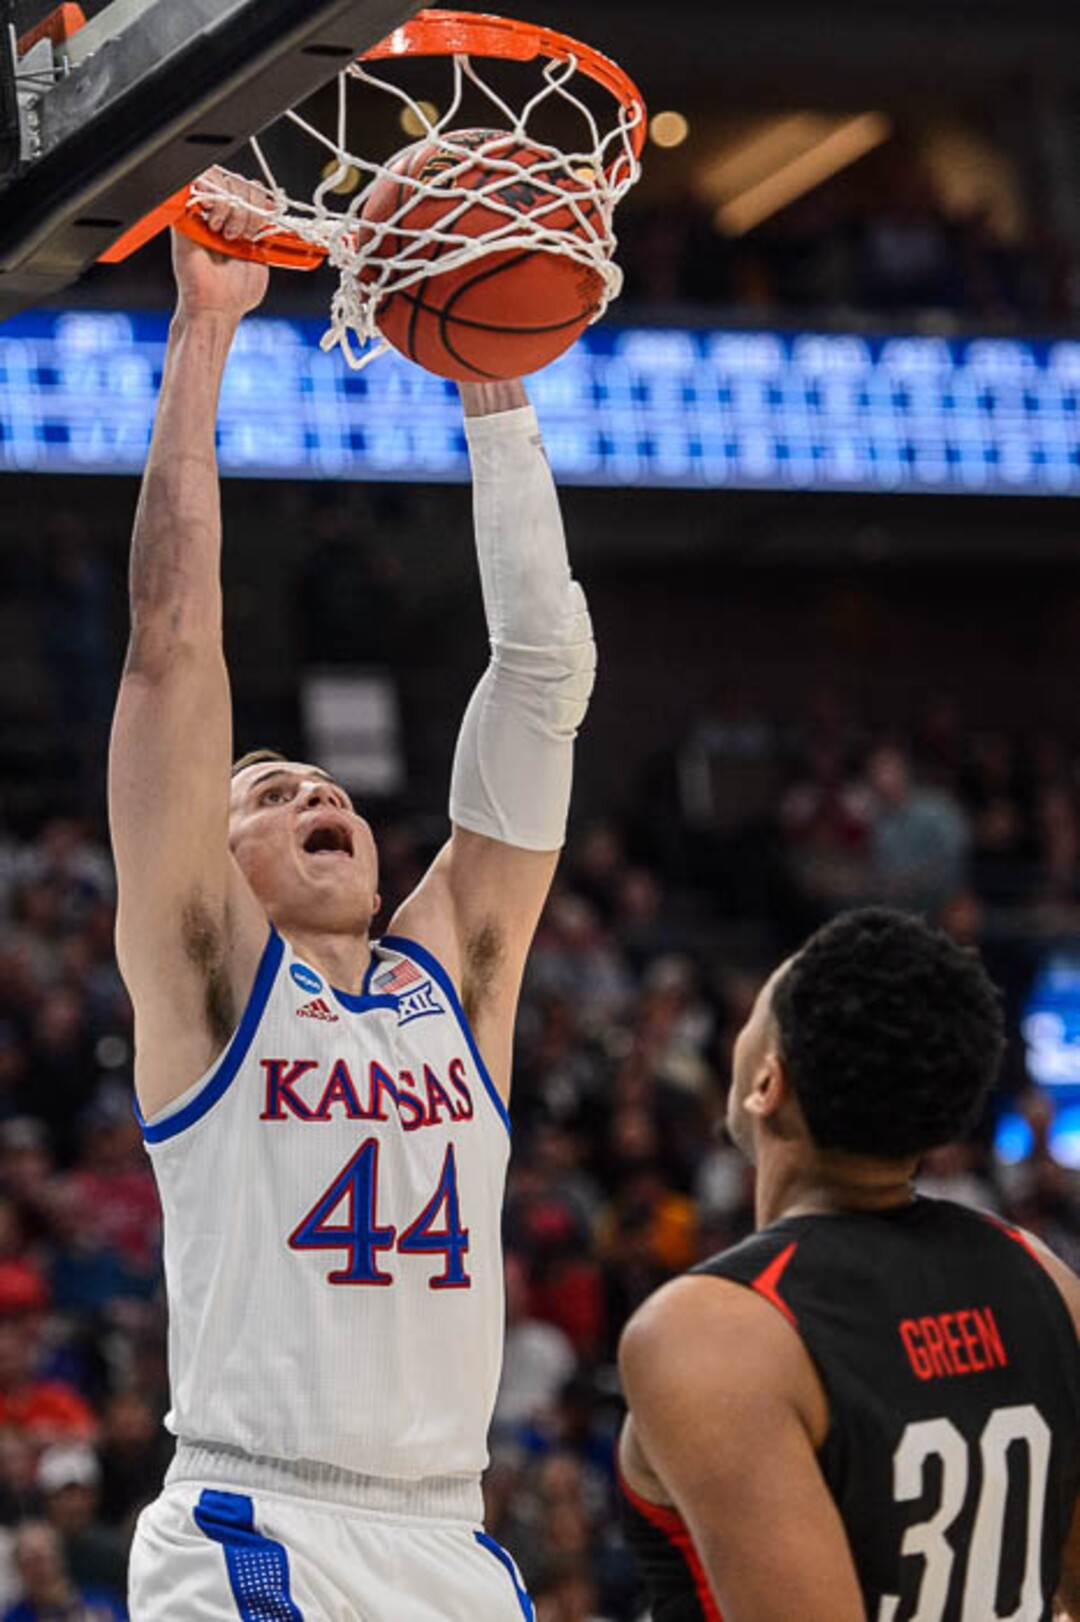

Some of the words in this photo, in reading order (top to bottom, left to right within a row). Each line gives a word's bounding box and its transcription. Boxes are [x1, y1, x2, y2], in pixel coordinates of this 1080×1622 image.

[260, 1058, 473, 1131] KANSAS
[288, 1137, 471, 1289] 44
[900, 1306, 1008, 1381] GREEN
[878, 1404, 1052, 1622] 30
